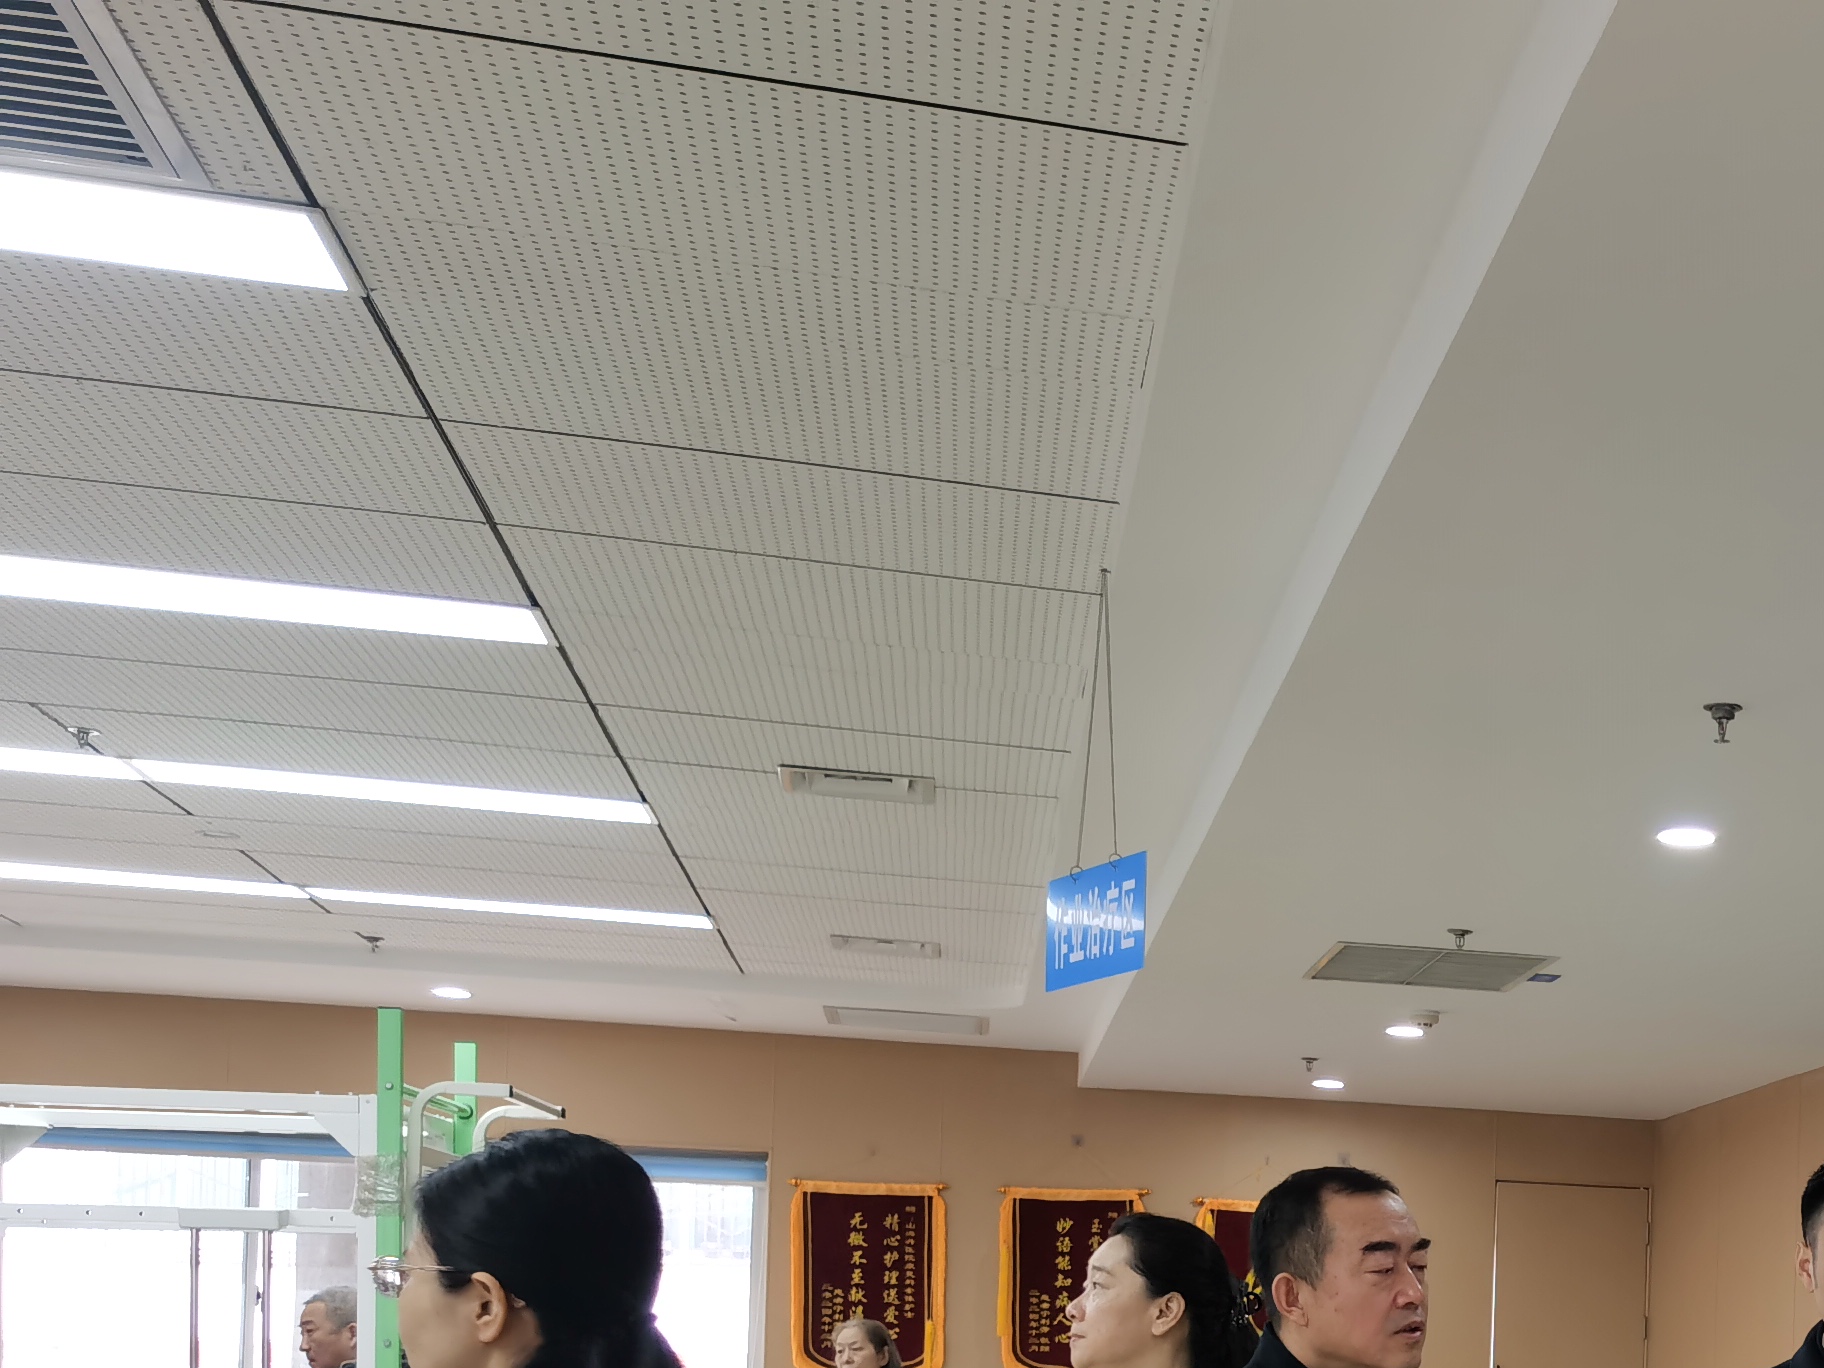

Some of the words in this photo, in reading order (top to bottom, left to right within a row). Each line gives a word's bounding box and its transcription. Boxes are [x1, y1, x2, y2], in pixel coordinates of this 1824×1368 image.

[1054, 879, 1136, 970] 作业治疗区
[1053, 1217, 1074, 1344] 妙语能知病人心
